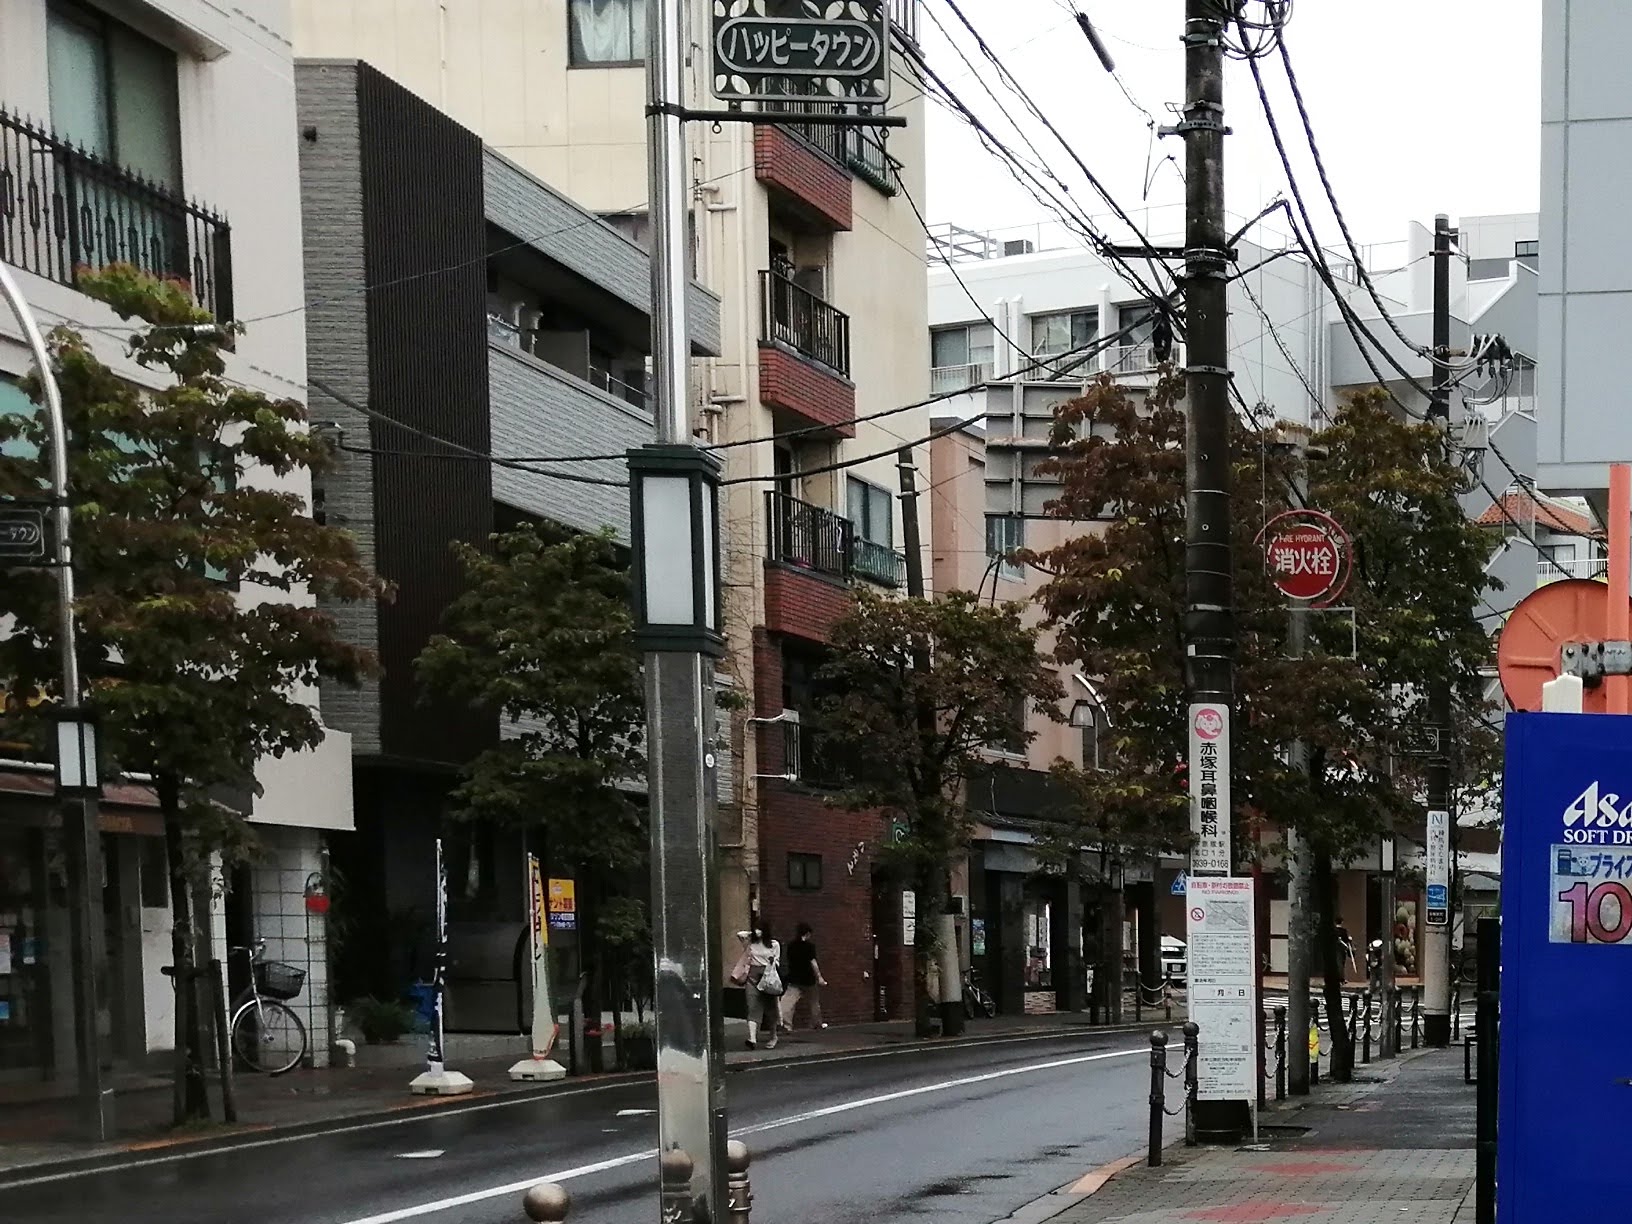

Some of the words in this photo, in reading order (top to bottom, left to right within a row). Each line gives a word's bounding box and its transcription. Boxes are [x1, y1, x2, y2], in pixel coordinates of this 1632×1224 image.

[728, 26, 873, 67] ハッピータウン
[1274, 546, 1332, 575] 消火栓
[1200, 742, 1217, 837] 赤塚耳鼻咽喉科
[1563, 829, 1609, 844] SOFT
[1217, 989, 1225, 997] 月
[1238, 989, 1245, 997] 日
